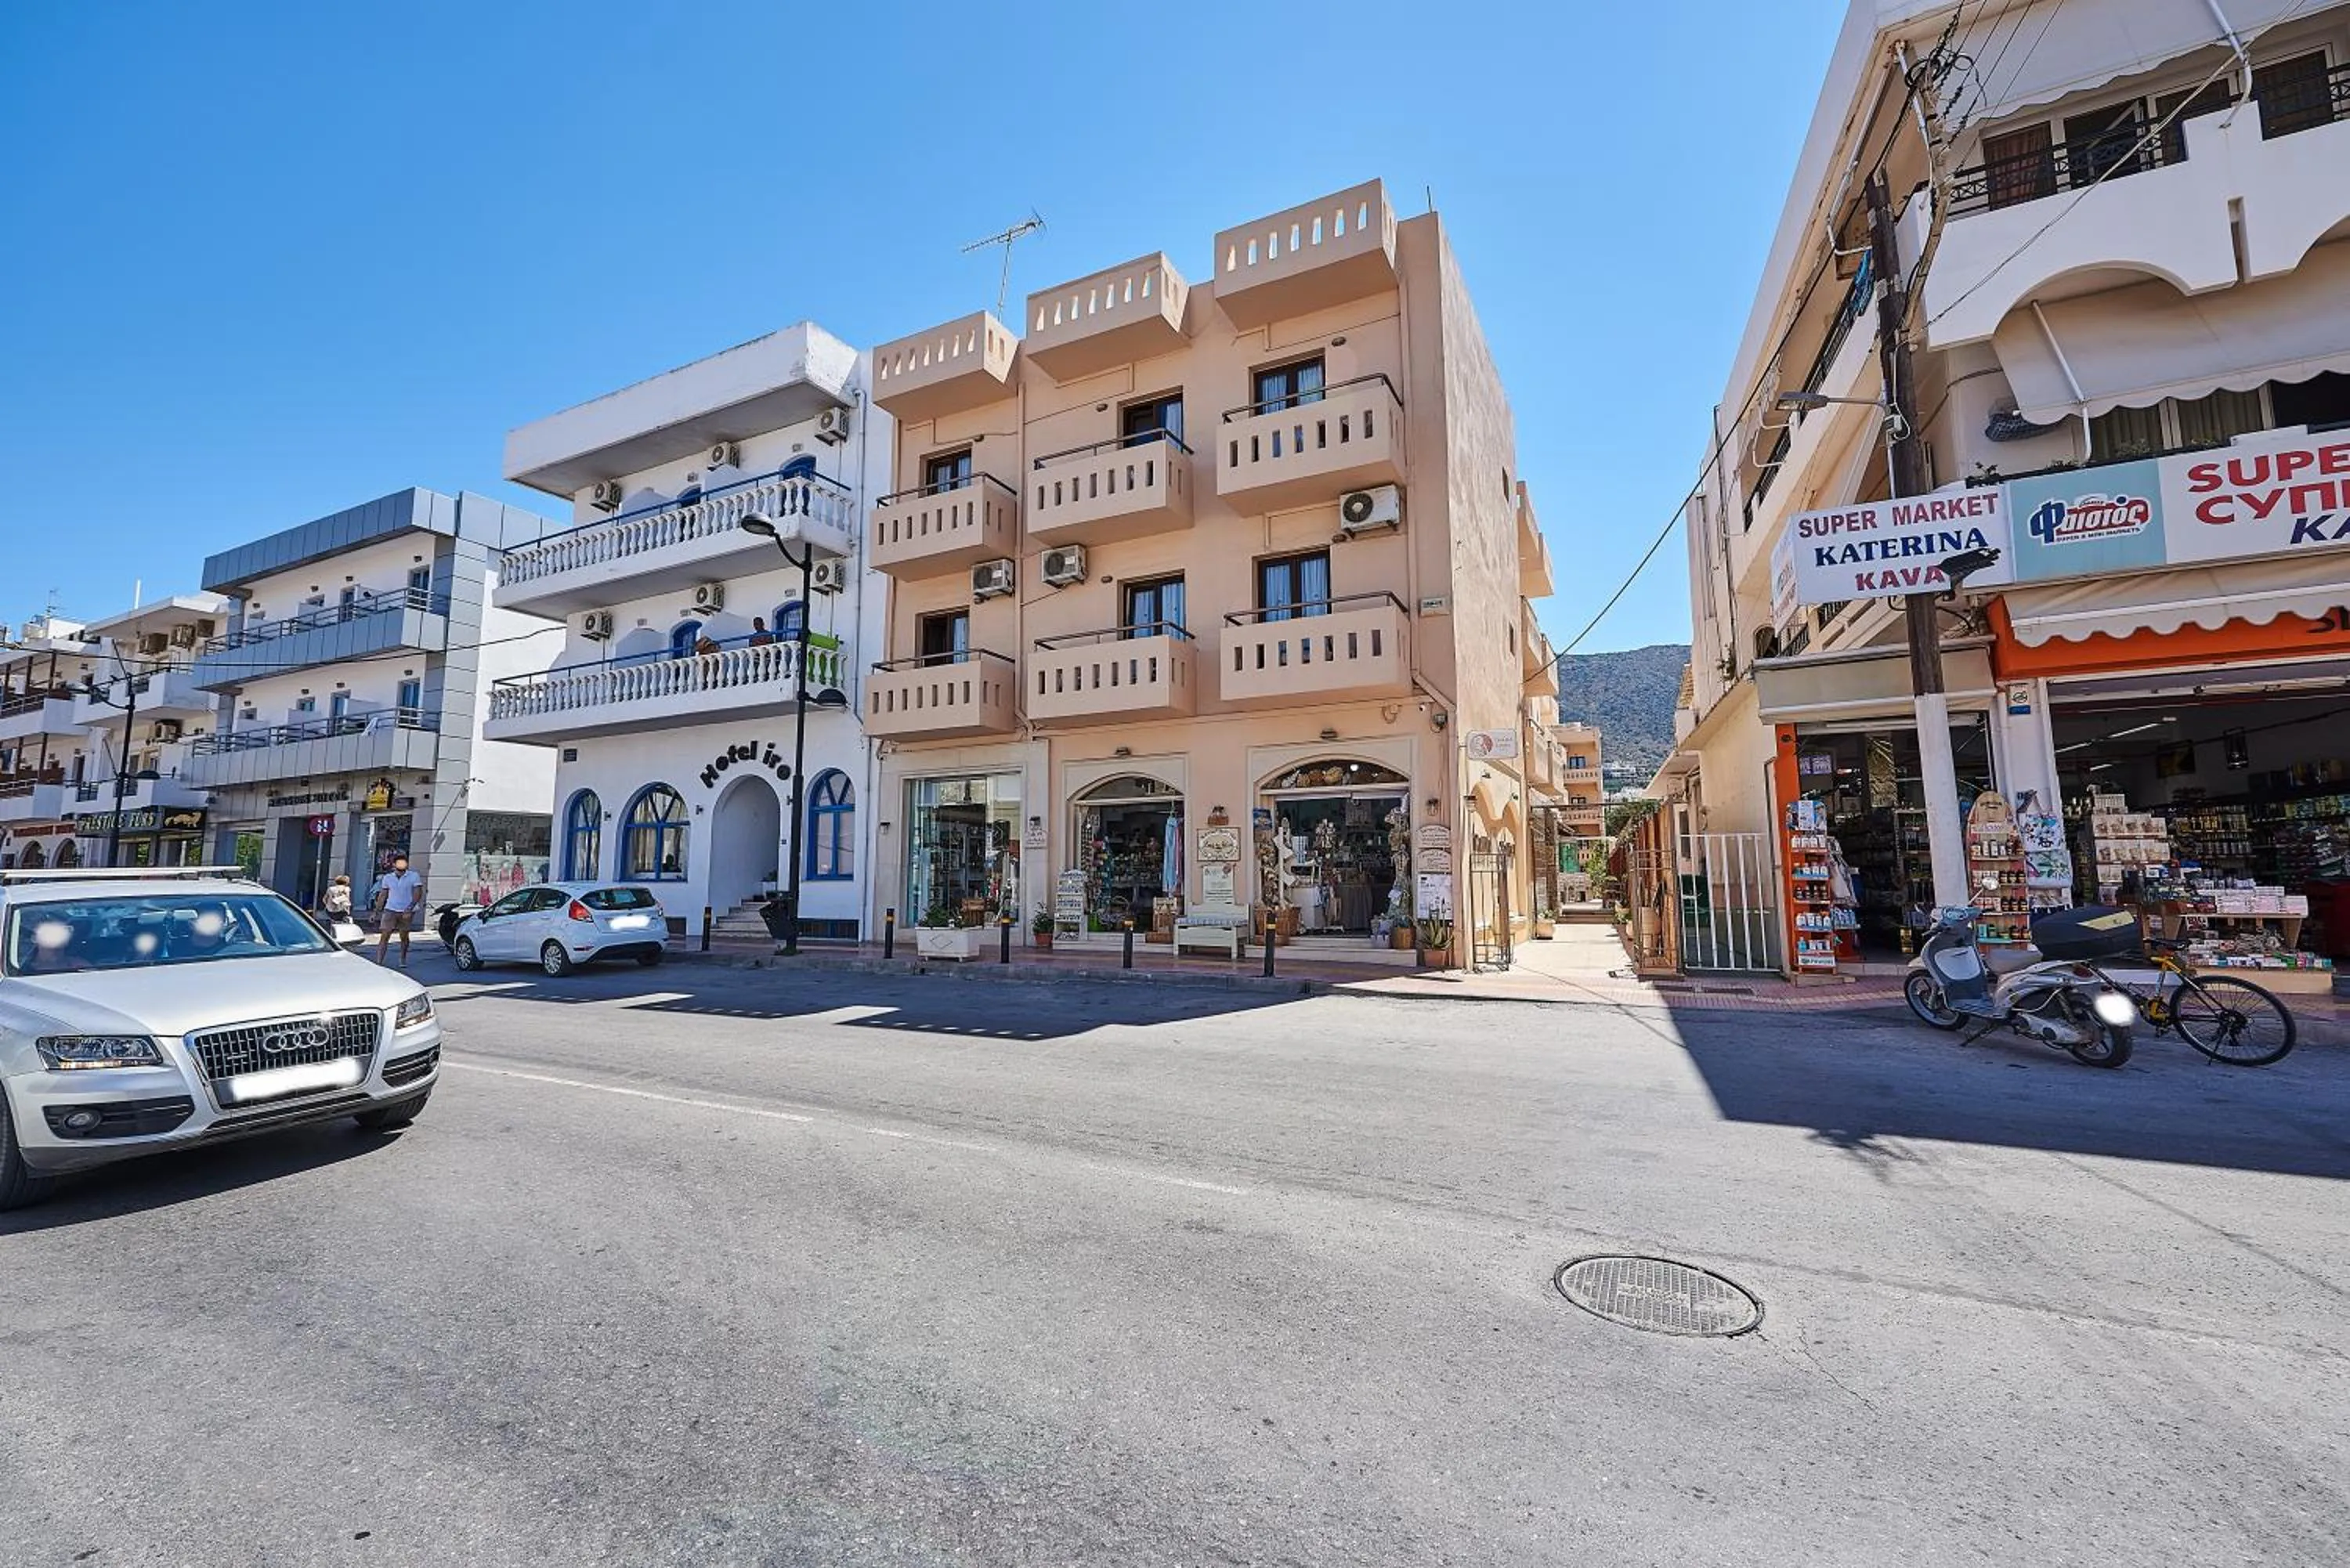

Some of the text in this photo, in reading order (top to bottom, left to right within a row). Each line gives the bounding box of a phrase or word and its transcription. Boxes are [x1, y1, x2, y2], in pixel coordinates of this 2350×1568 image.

[1799, 493, 1998, 539] SUPER MARKET
[2196, 479, 2350, 525] СУП
[1815, 527, 1989, 567] KATERINA
[1855, 565, 1946, 591] KAVA
[700, 740, 758, 789] Hotel
